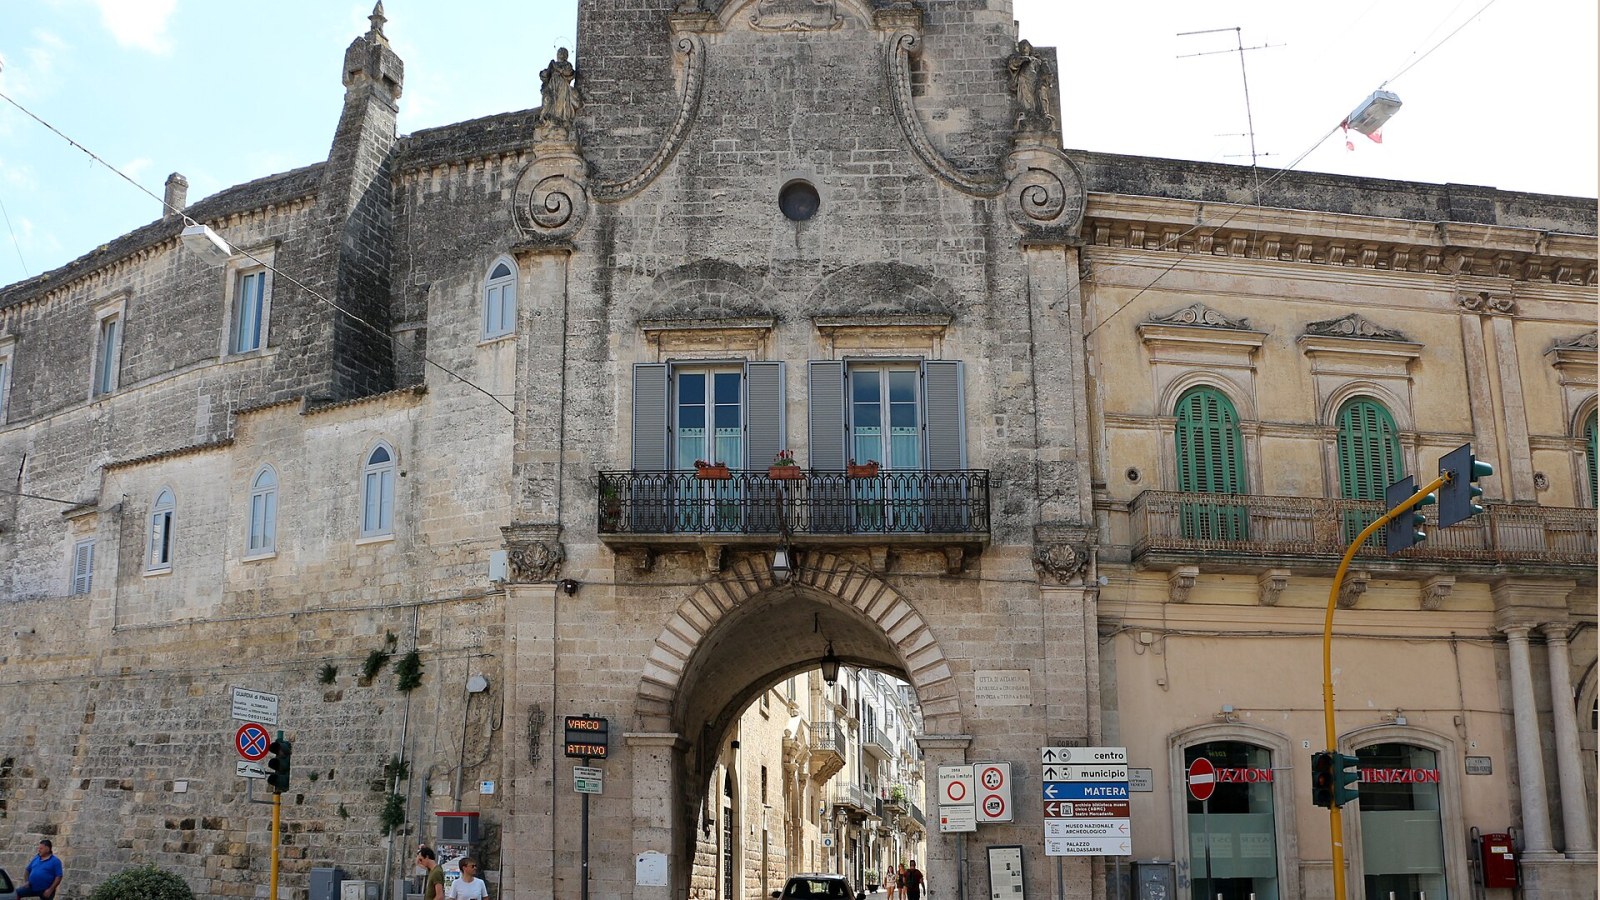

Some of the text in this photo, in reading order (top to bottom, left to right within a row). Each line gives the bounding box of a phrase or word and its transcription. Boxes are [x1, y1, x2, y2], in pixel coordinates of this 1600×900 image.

[236, 690, 253, 699] GUARDIA
[568, 720, 599, 730] VARCO
[568, 745, 605, 755] ATTIVO
[1081, 770, 1125, 779] municipio
[1216, 768, 1273, 782] TAZIONI
[1361, 768, 1440, 783] TENTAZIONI
[1084, 787, 1126, 796] MATERA
